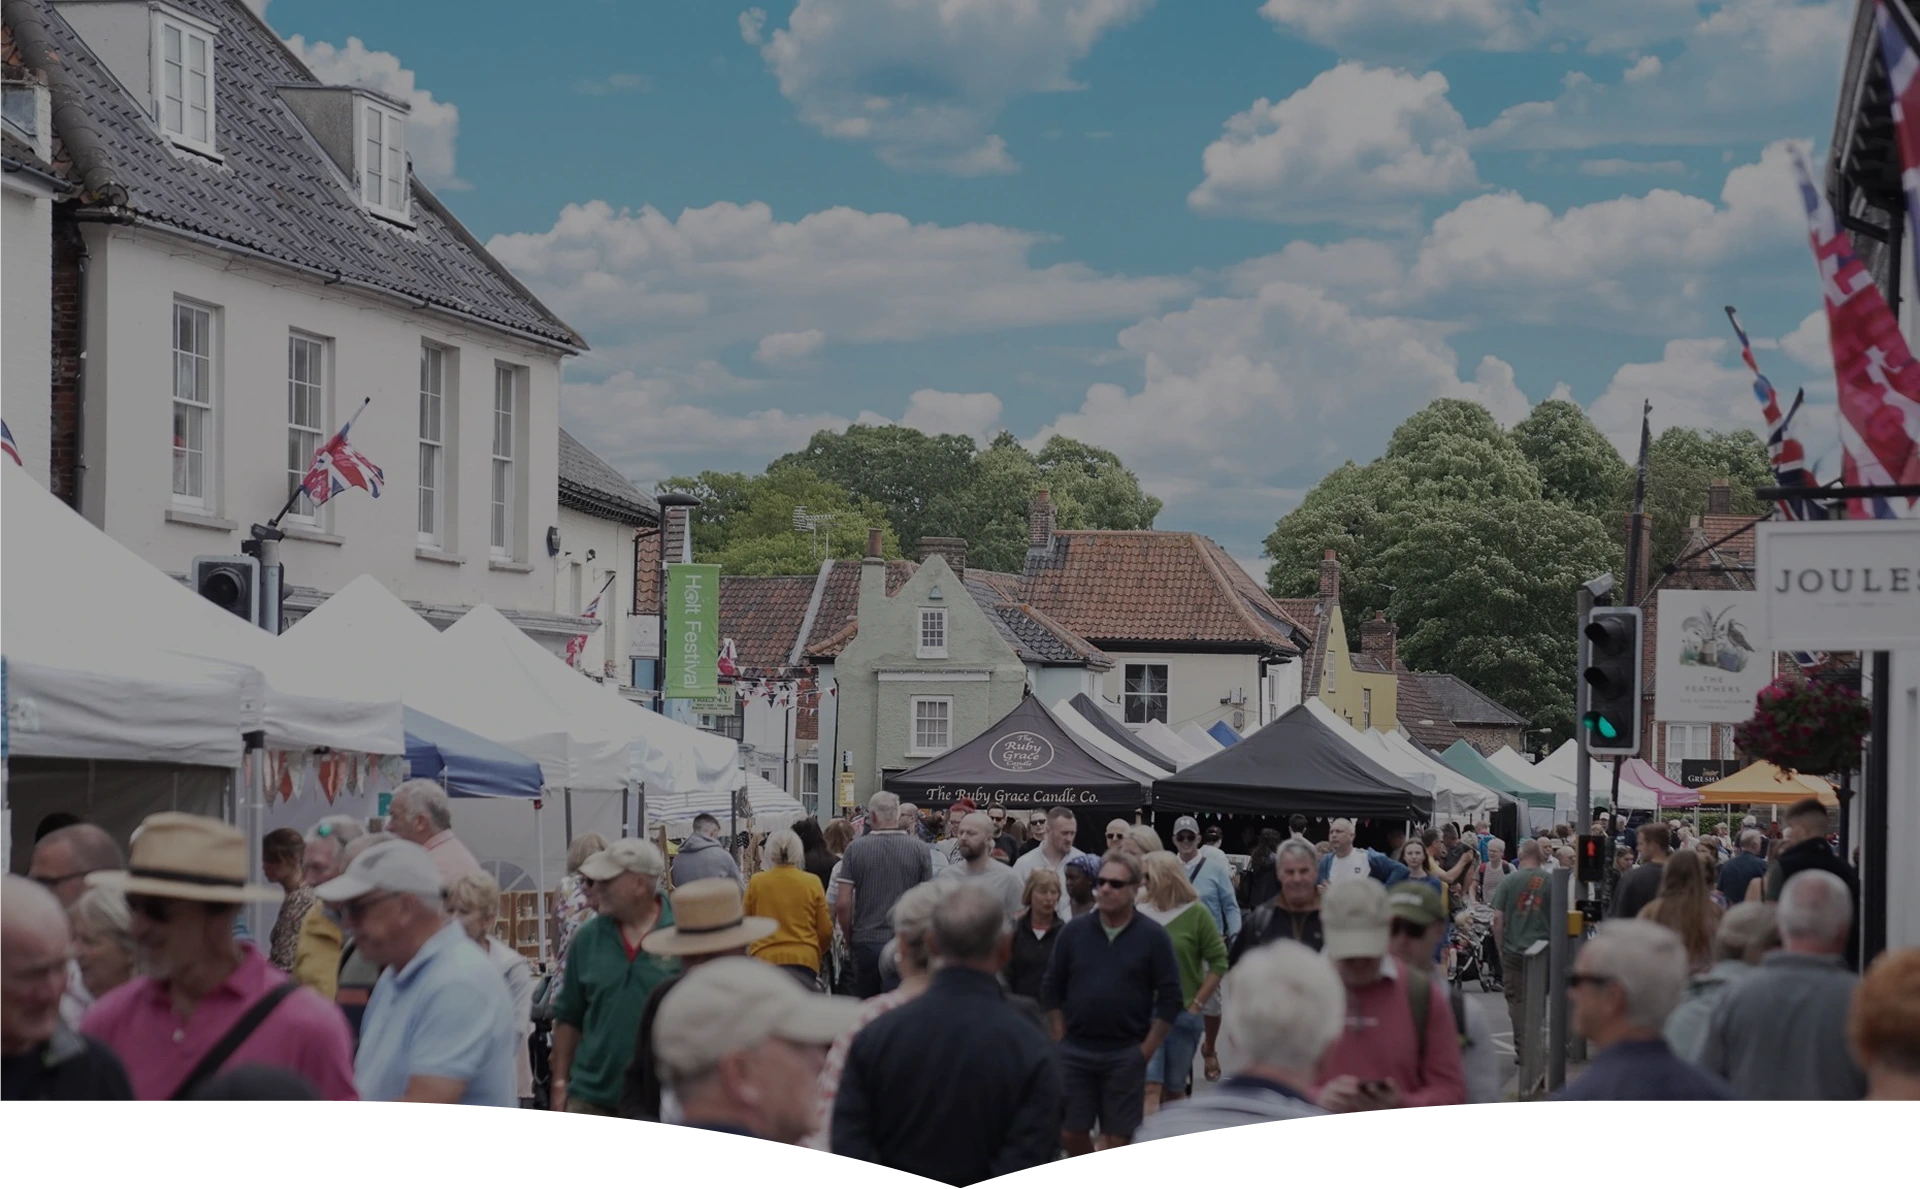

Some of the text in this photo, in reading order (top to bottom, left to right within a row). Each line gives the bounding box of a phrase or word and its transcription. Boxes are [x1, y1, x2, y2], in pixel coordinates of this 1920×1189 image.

[1775, 568, 1920, 594] JOULE
[684, 574, 702, 689] Holt Festival
[1685, 685, 1741, 693] FEATHERS
[1016, 734, 1033, 742] The
[1004, 740, 1041, 755] Ruby
[1002, 750, 1039, 761] Grace
[926, 785, 1099, 807] The Ruby Grace Candle Co.
